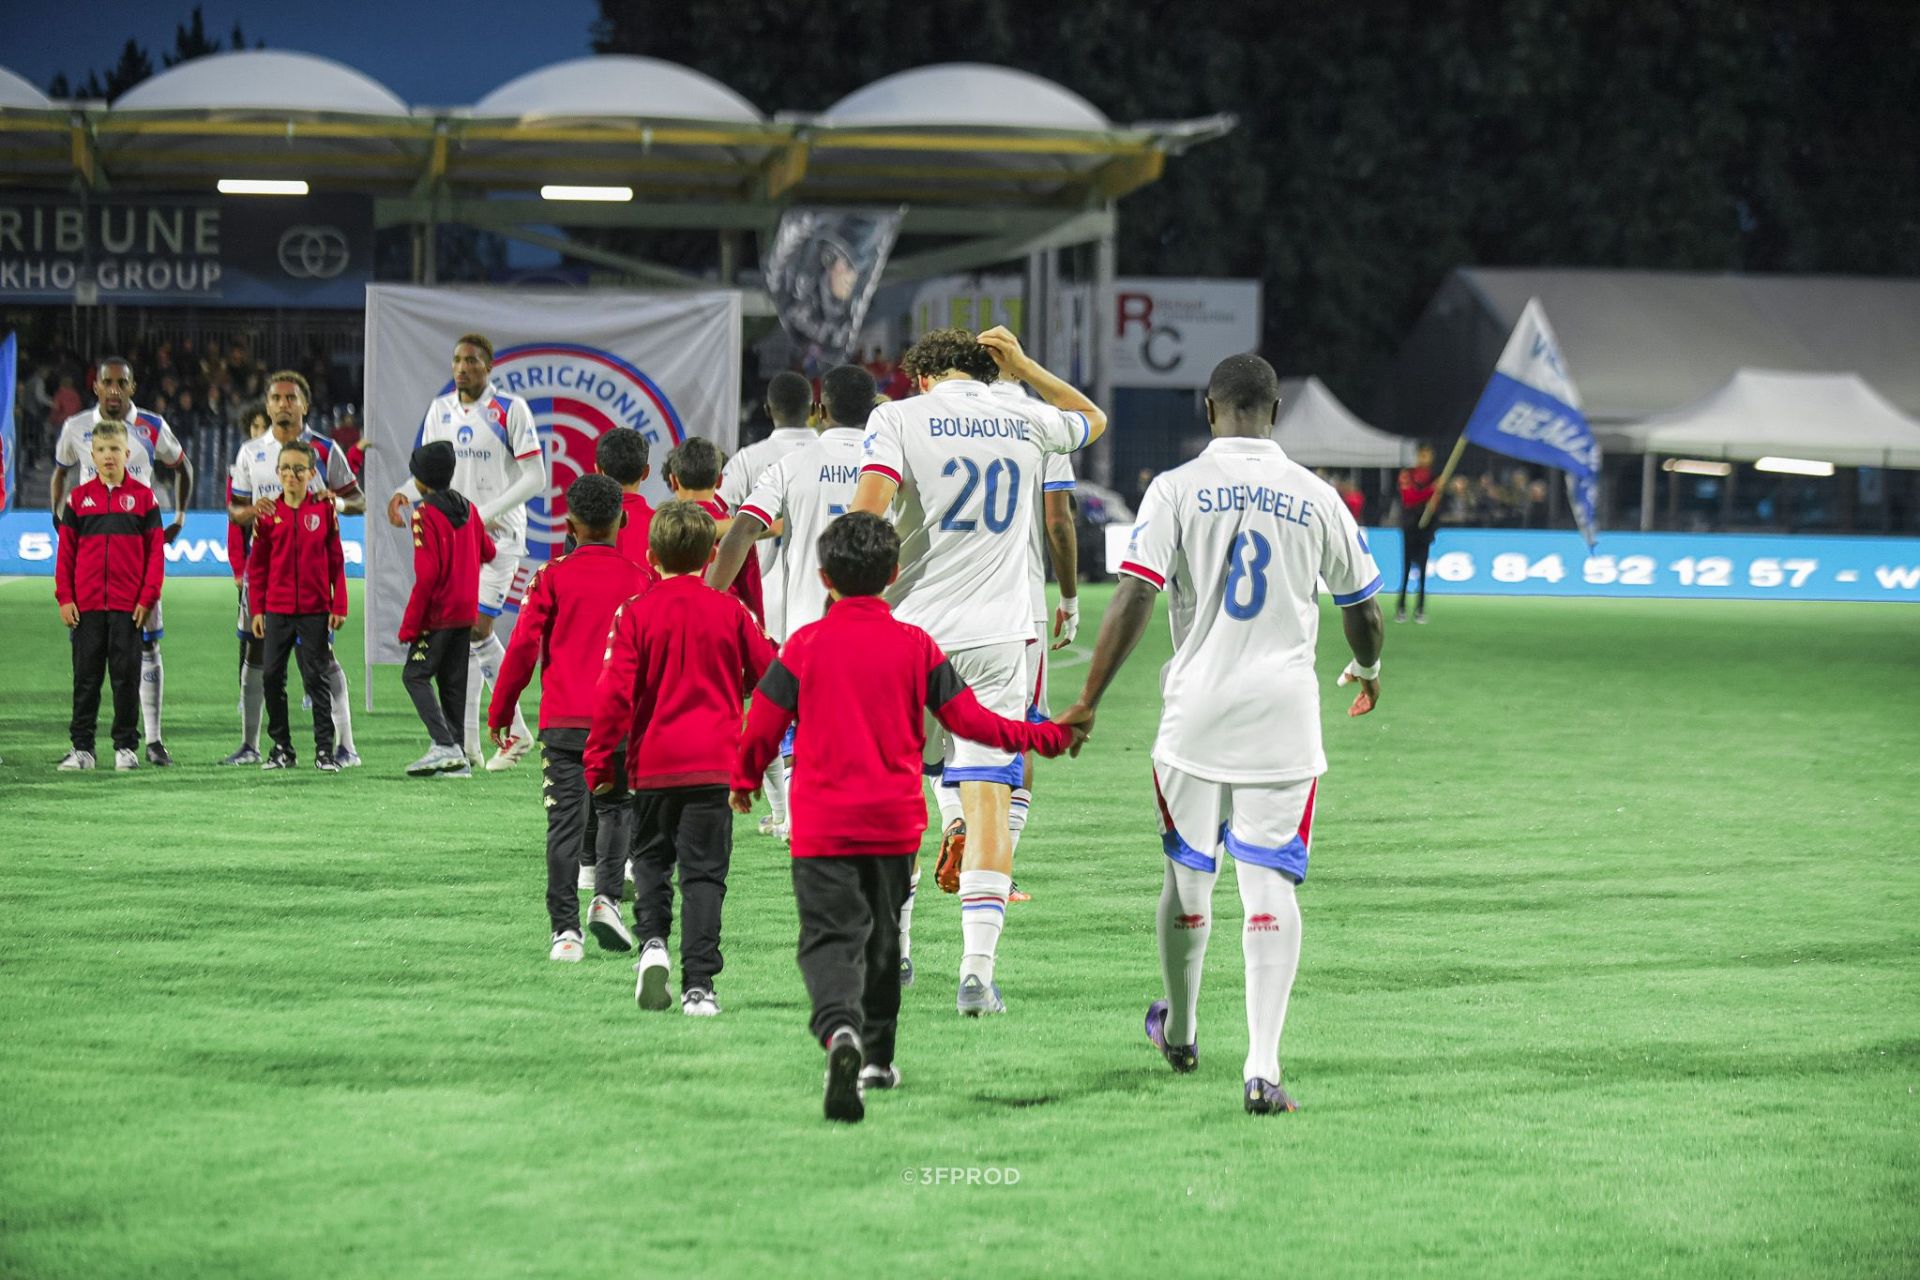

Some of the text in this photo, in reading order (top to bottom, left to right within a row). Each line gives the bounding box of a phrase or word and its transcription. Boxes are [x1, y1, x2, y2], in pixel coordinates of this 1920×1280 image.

[0, 207, 222, 255] RIBUNE
[1, 260, 222, 291] KHO GROUP
[492, 364, 660, 447] RRICHONNE
[929, 417, 1031, 441] BOUAOUNE
[818, 464, 861, 485] AHM
[939, 455, 1021, 535] 20
[1197, 484, 1314, 527] S.DEMBELE
[1224, 529, 1272, 622] 8
[1424, 551, 1476, 582] 6
[1491, 552, 1567, 583] 84
[1583, 553, 1658, 585] 52
[1670, 556, 1735, 587] 12
[1748, 557, 1819, 588] 57
